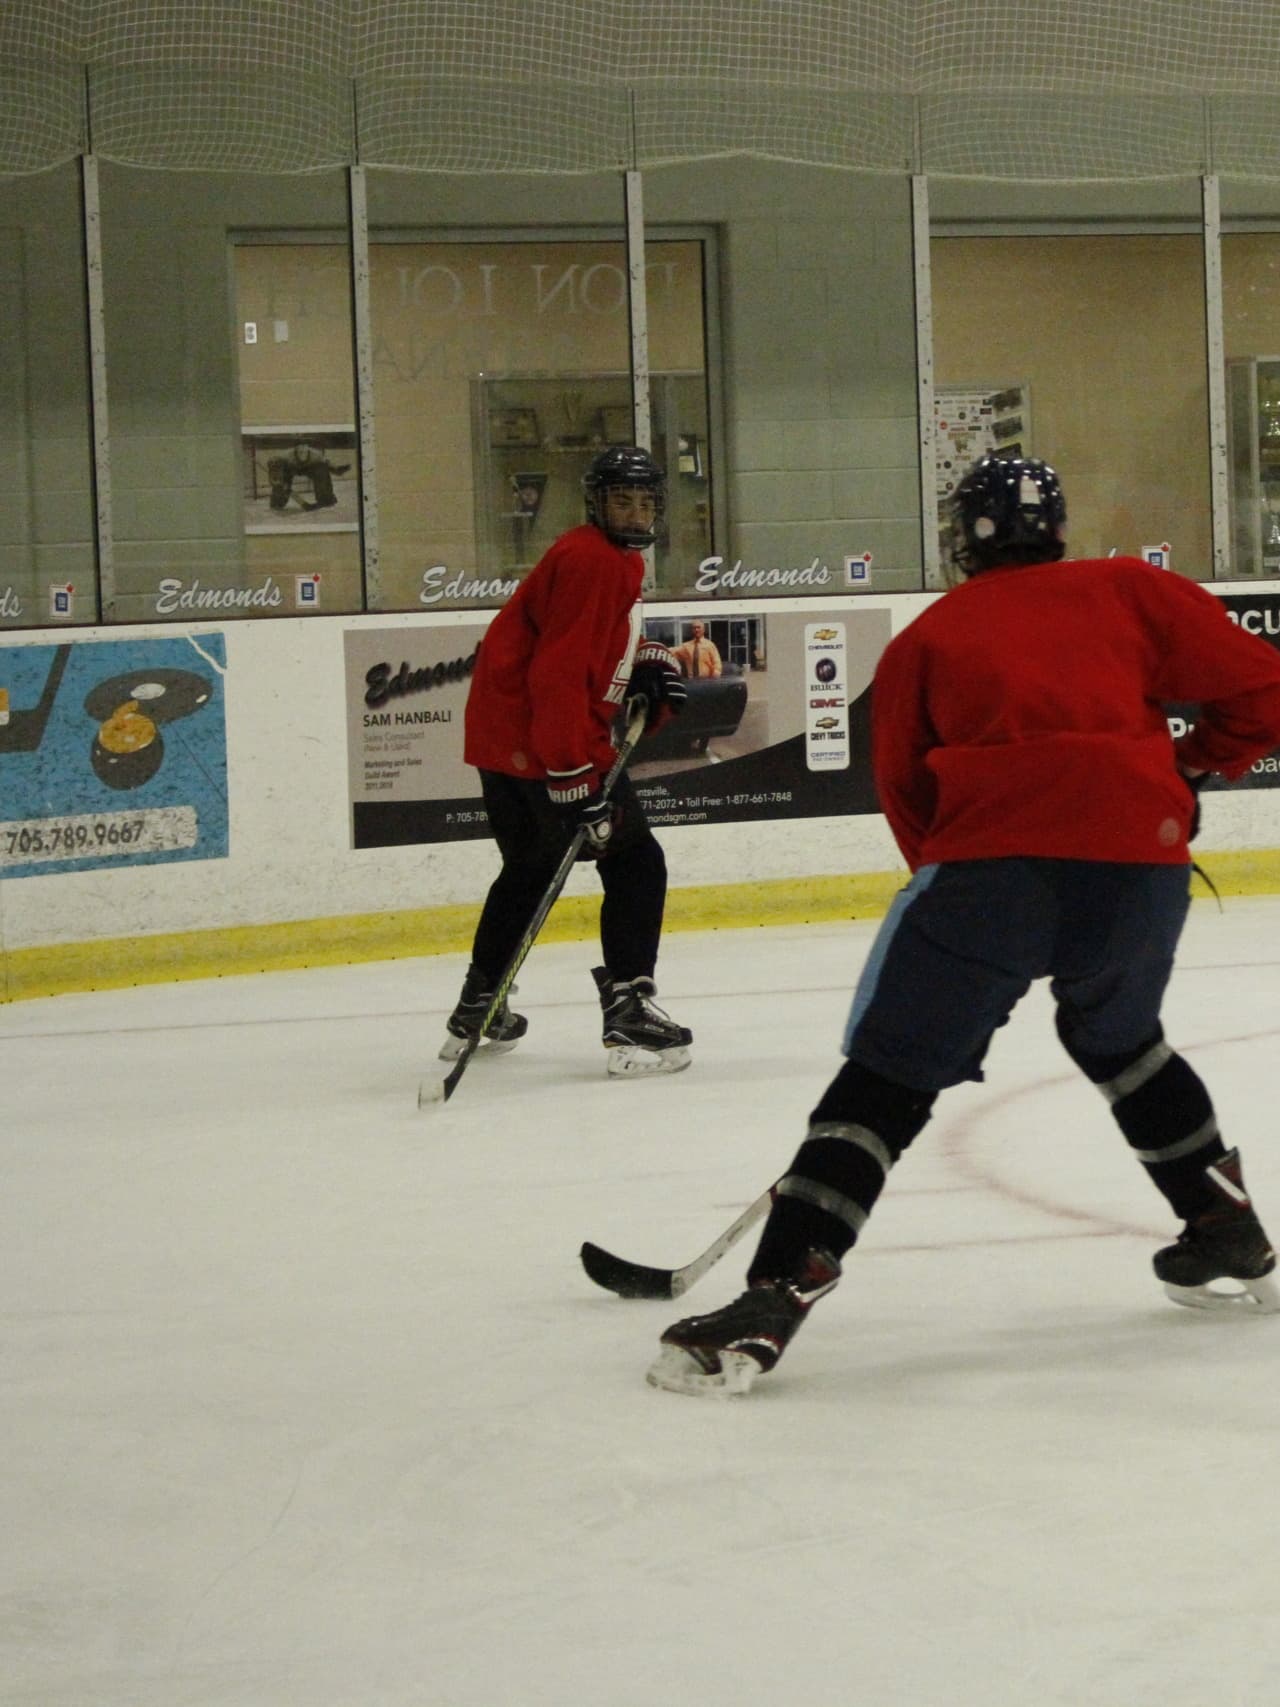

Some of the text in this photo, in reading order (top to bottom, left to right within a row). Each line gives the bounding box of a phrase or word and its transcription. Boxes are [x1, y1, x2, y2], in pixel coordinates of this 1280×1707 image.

[420, 566, 520, 603] Edmon
[695, 556, 833, 592] Edmonds
[155, 577, 283, 614] Edmonds
[810, 683, 844, 692] BUICK
[810, 698, 845, 708] GMC
[363, 710, 452, 727] SAM HANBALI
[685, 797, 700, 808] Toll
[726, 792, 793, 804] 1-877-661-7848
[6, 820, 145, 854] 705.789.9667
